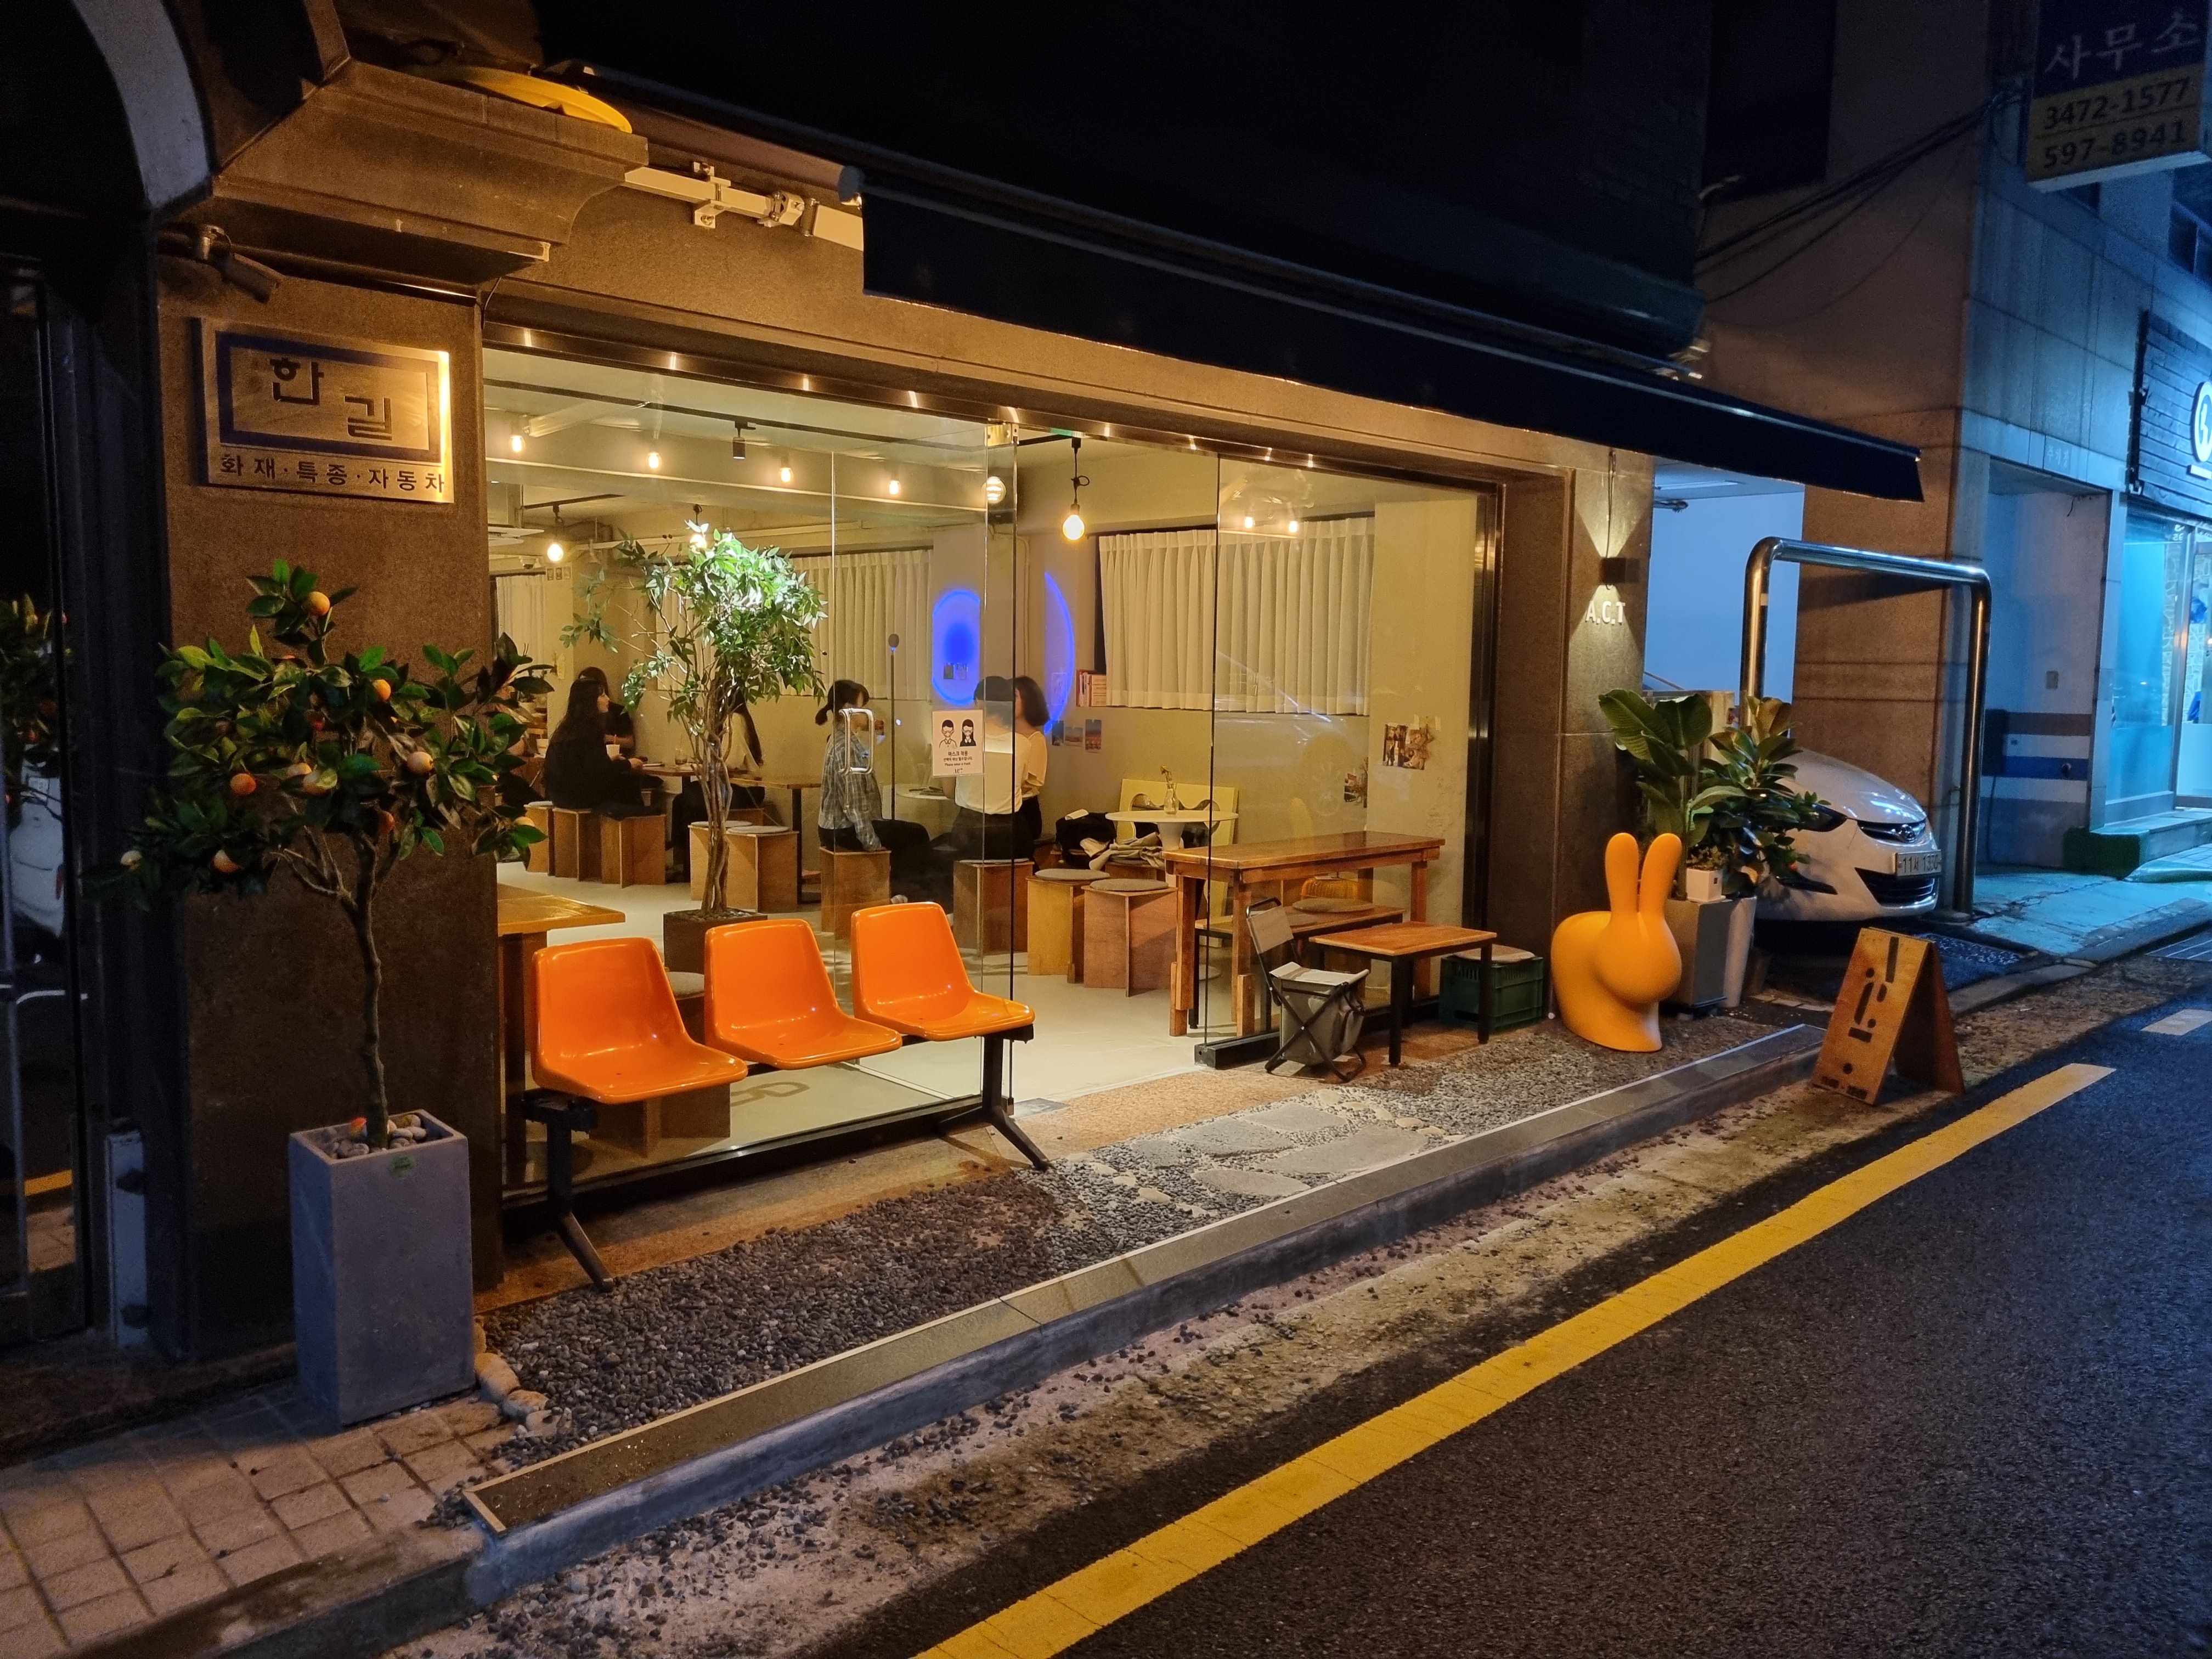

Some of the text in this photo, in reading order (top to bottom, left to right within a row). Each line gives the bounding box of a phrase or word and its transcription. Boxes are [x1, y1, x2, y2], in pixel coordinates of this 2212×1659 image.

[2044, 8, 2202, 81] 사무소
[2044, 77, 2191, 131] 3472-1577
[2043, 119, 2188, 169] 597-8941
[269, 357, 393, 441] 한길
[1584, 600, 1626, 625] A.C.T
